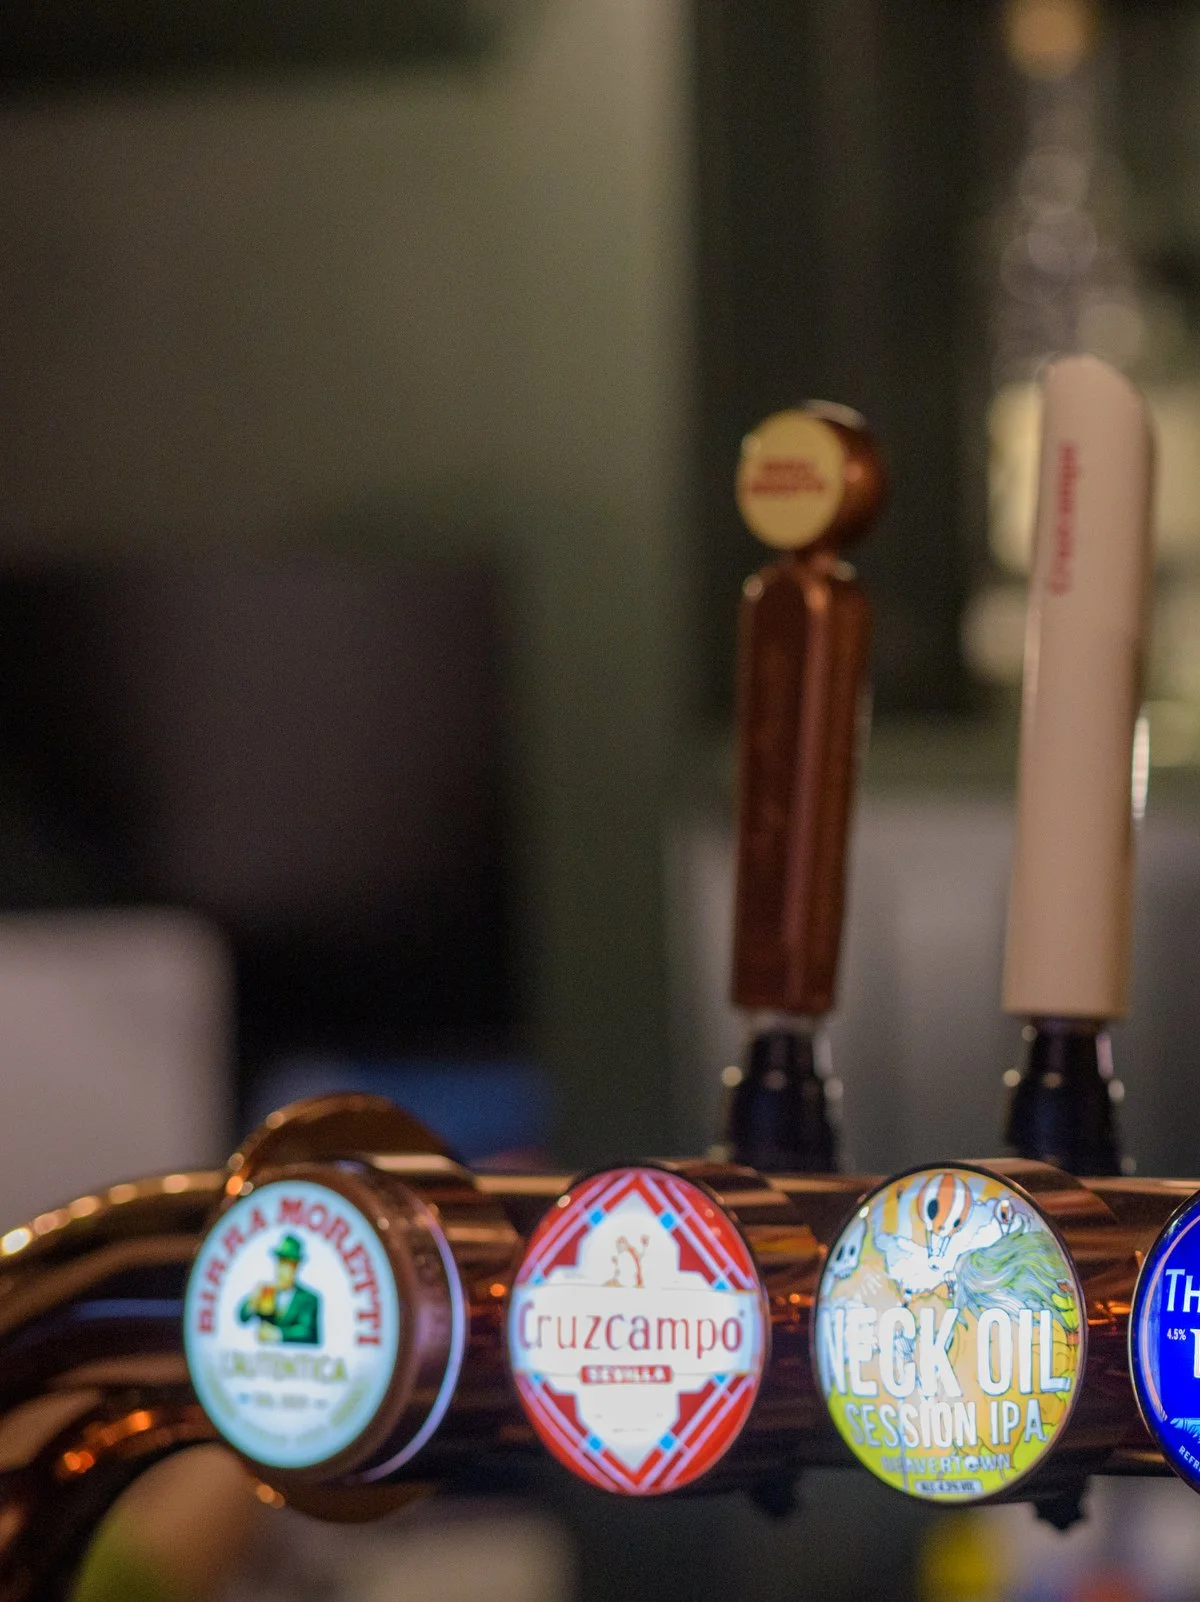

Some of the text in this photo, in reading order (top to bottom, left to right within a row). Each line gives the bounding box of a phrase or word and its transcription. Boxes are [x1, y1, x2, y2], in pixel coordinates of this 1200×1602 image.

[197, 1196, 382, 1346] BIRRA MORETTI
[518, 1300, 744, 1360] Cruzcampo
[818, 1306, 1071, 1399] NECK OIL
[1166, 1327, 1187, 1342] 4.5%
[845, 1398, 1048, 1449] SESSION IPA
